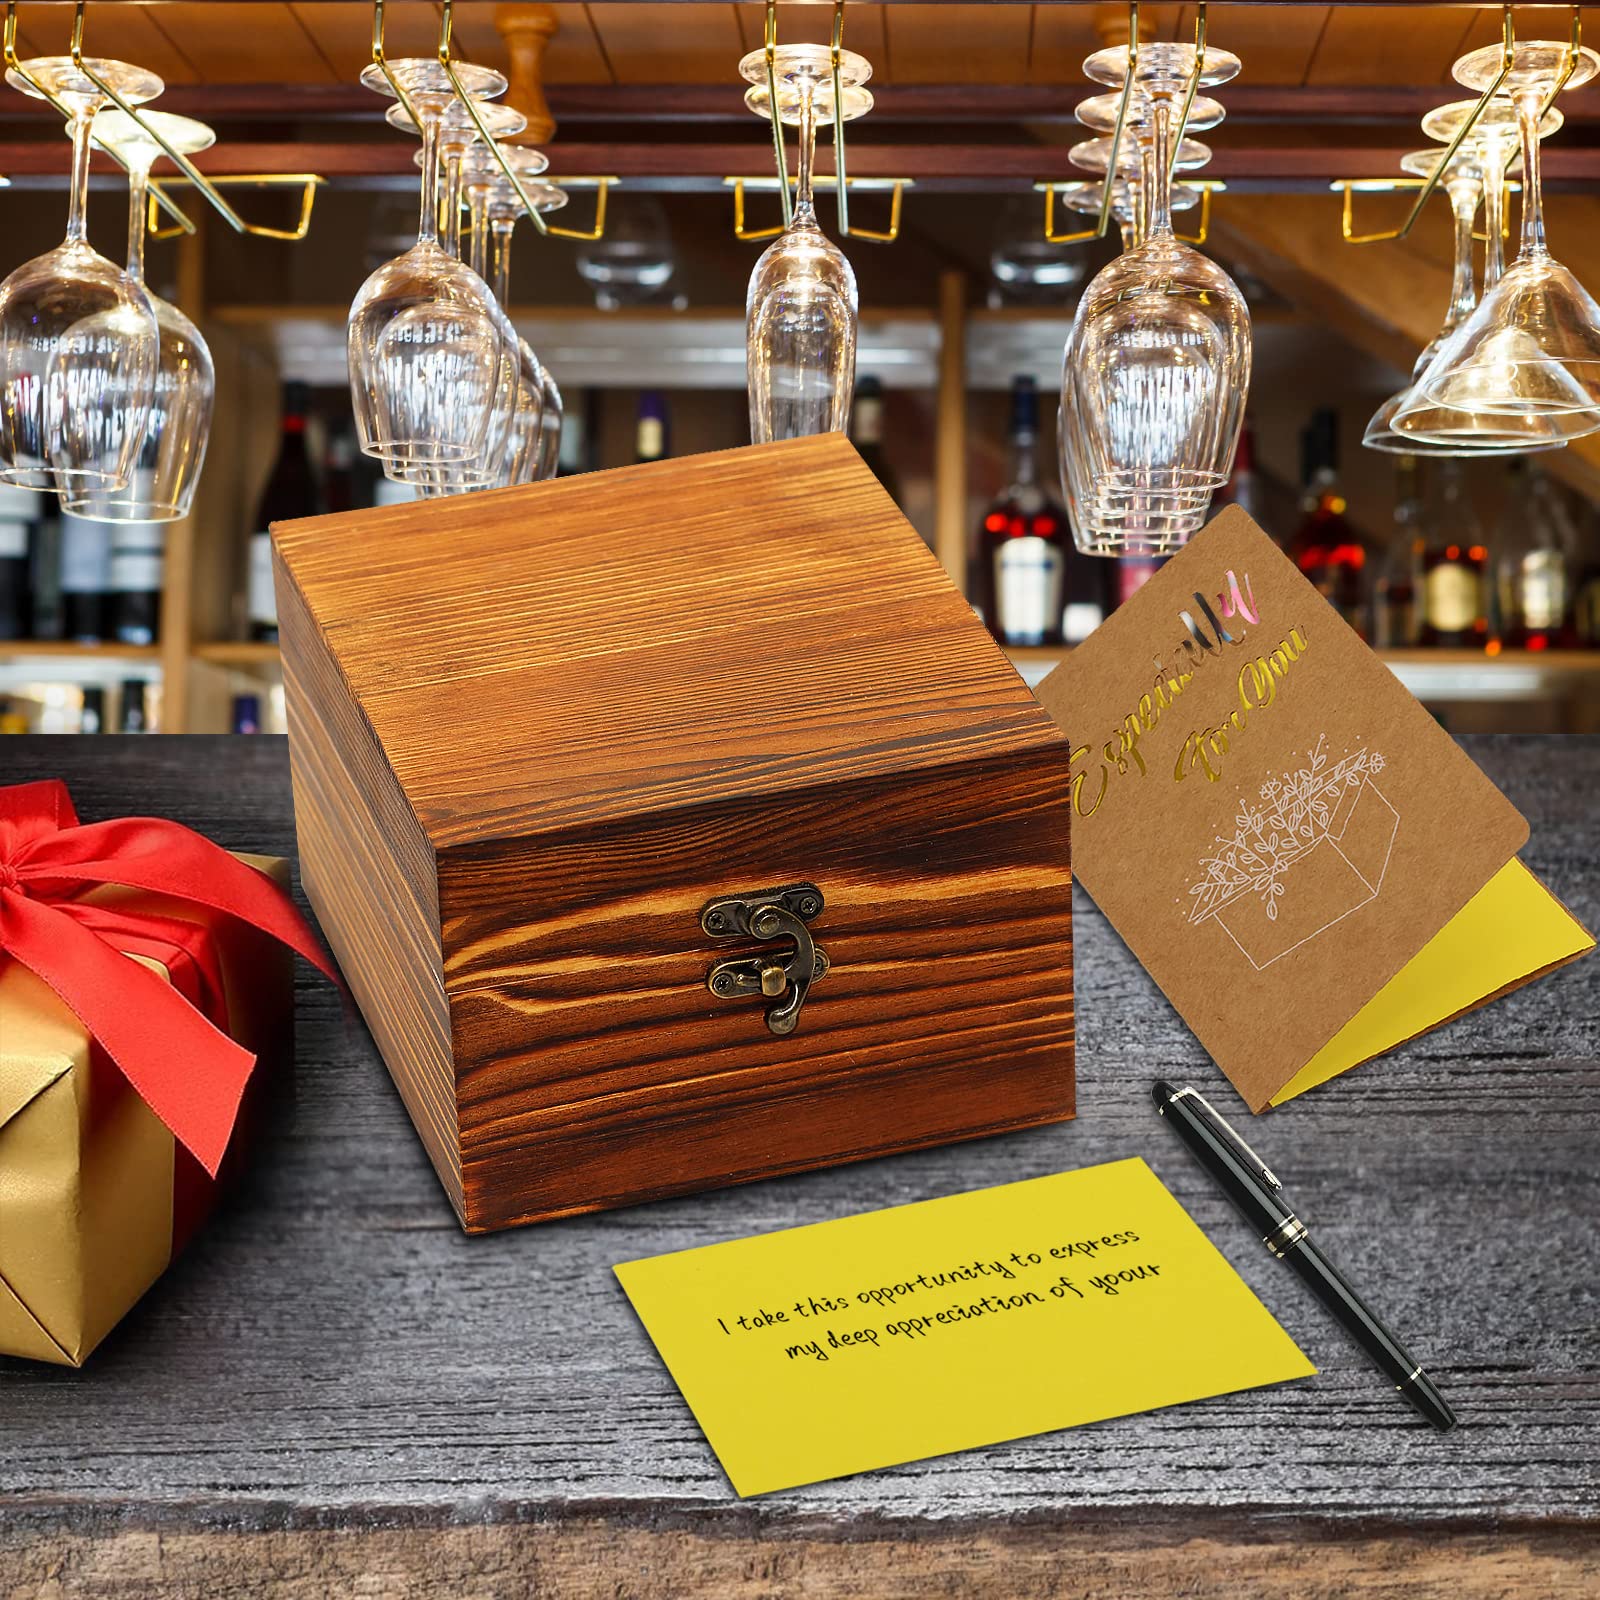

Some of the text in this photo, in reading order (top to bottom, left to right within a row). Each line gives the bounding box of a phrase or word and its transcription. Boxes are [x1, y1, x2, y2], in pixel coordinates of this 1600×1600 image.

[1070, 570, 1260, 817] Especially
[1174, 625, 1309, 783] For You
[717, 1228, 1141, 1335] I take this opportunity to express
[784, 1262, 1162, 1361] my deep appreciation of yoour
